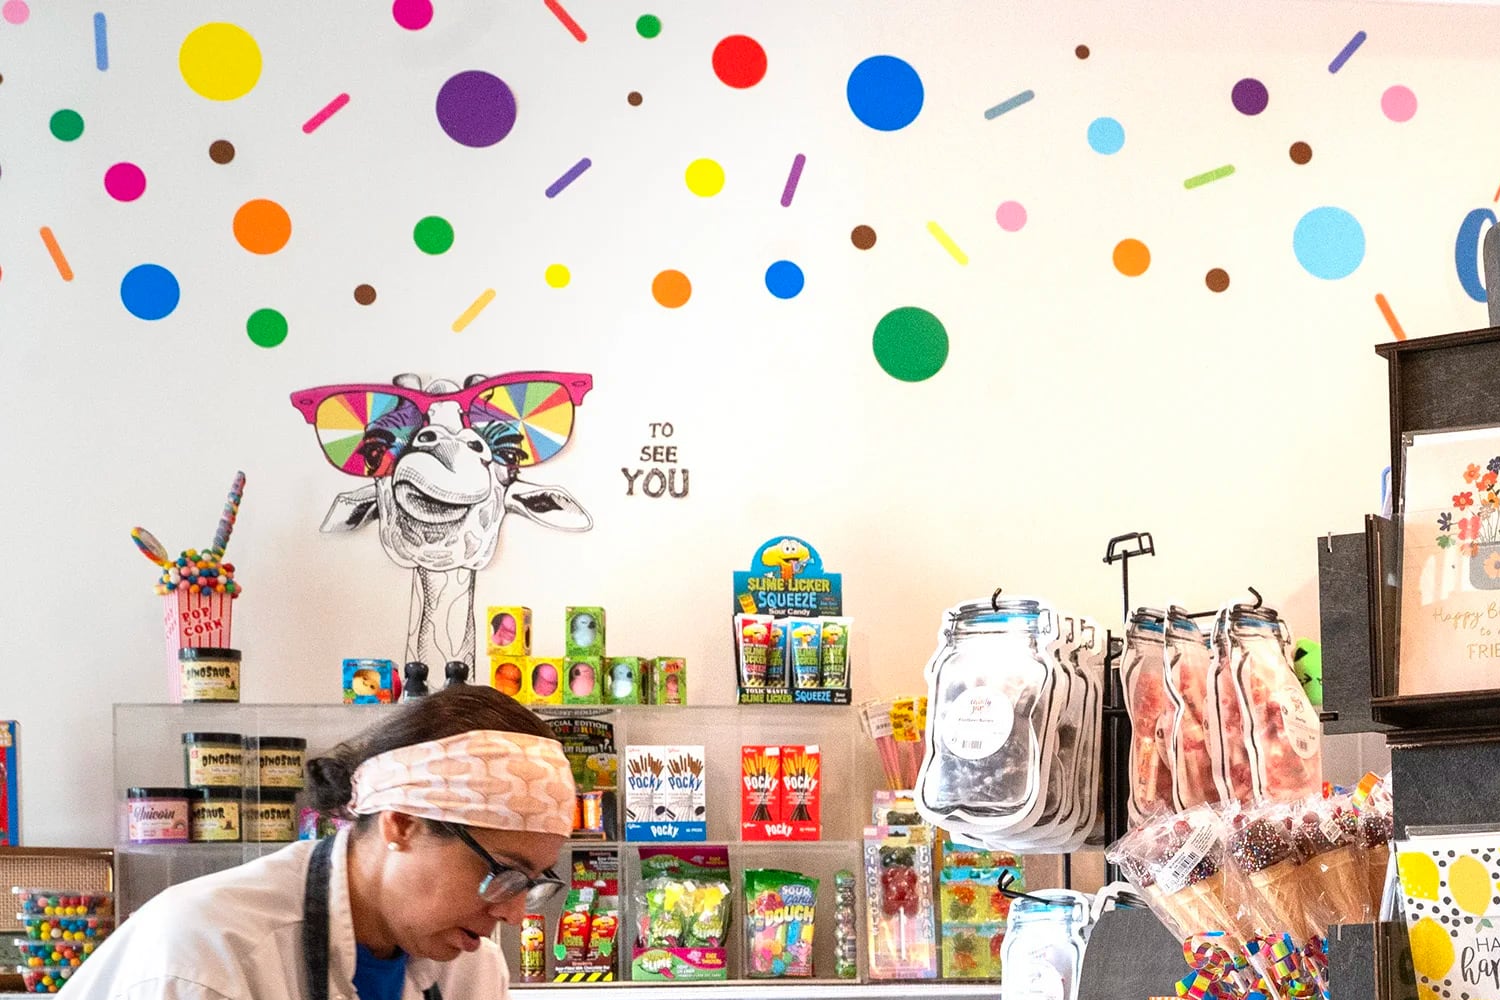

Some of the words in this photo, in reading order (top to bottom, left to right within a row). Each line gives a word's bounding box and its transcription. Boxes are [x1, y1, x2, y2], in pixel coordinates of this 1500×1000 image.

[648, 422, 674, 438] TO
[640, 446, 678, 463] SEE
[621, 467, 690, 499] YOU
[748, 578, 785, 592] SLIME
[788, 578, 830, 593] LICKER
[758, 592, 817, 608] SQUEEZE
[181, 606, 210, 625] POP
[769, 608, 787, 616] Sour
[787, 608, 811, 617] Candy
[1433, 604, 1484, 628] Happy
[183, 617, 223, 638] CORN
[1480, 625, 1495, 638] to
[187, 665, 231, 679] DINOSAUR
[795, 690, 831, 703] SQUEEZE
[132, 806, 176, 823] Unicorn
[781, 885, 810, 897] SOUR
[765, 906, 815, 926] DOUGH
